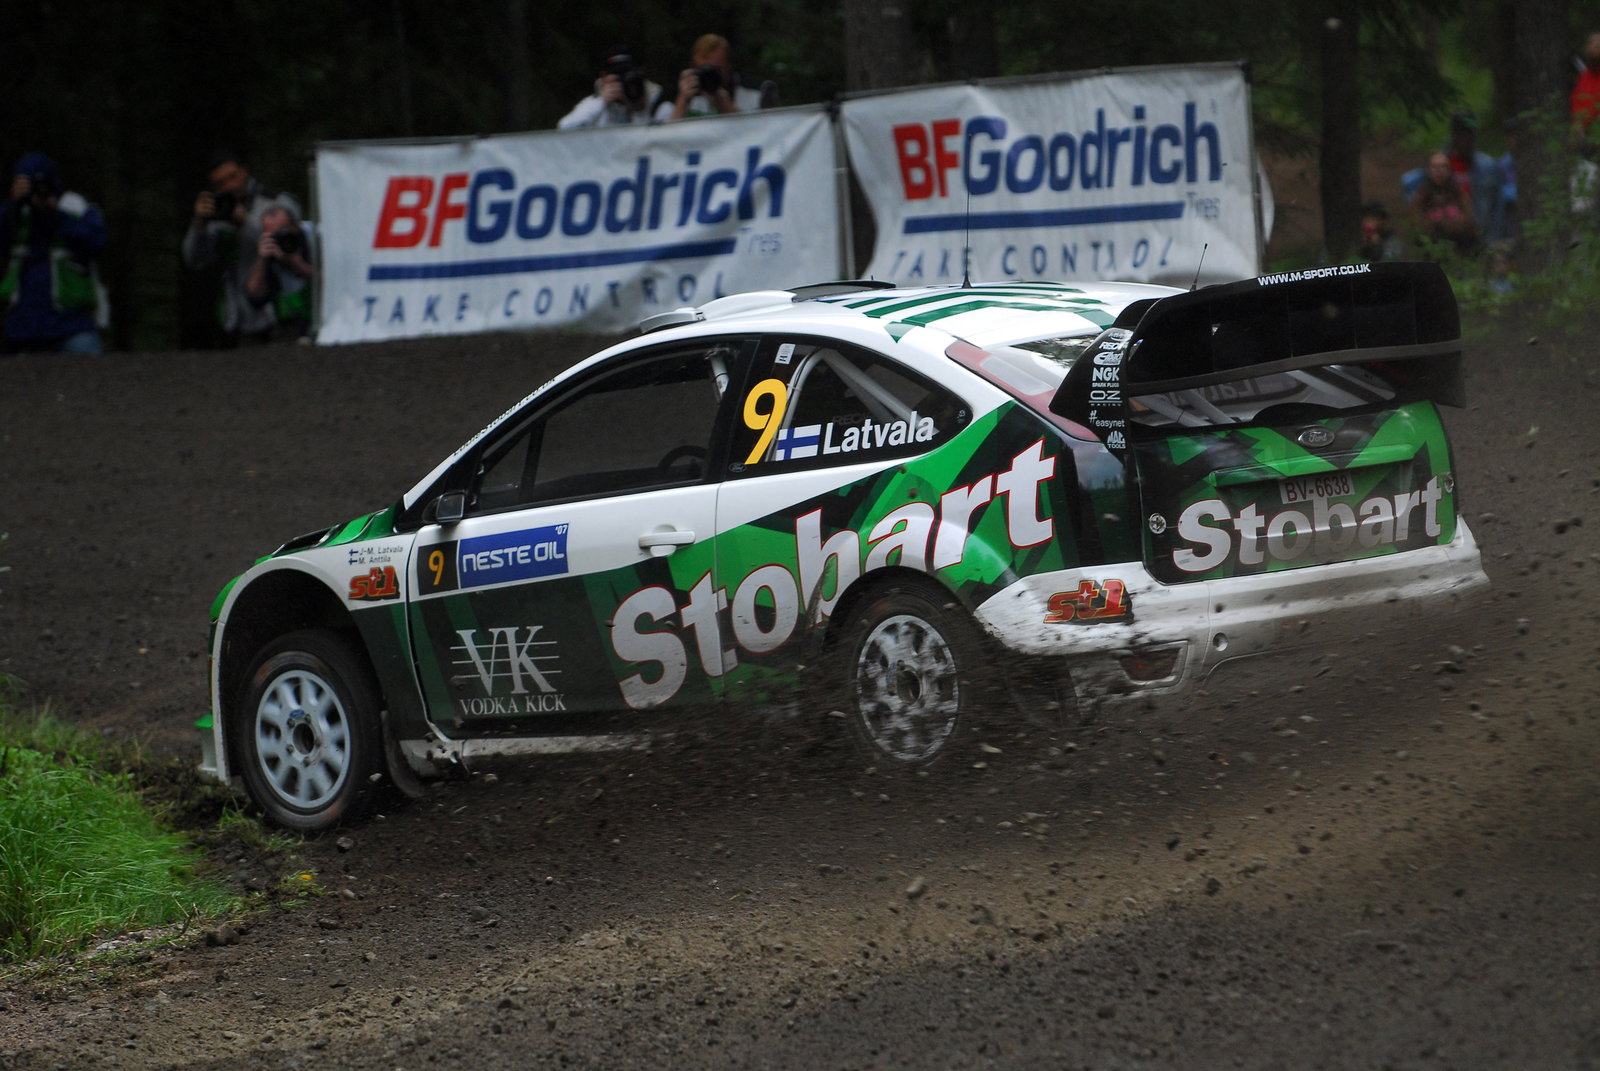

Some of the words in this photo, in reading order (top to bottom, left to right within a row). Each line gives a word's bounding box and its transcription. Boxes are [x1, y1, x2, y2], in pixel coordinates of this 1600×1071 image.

[892, 101, 1222, 201] BFGoodrich
[372, 145, 786, 250] BFGoodrich
[1001, 237, 1174, 277] CONTROL
[1257, 263, 1371, 286] WWW.M-SPORT.CO.UK
[363, 293, 469, 325] TAKE
[503, 271, 727, 318] CONTROL
[1092, 367, 1119, 381] NGK
[742, 378, 788, 465] 9
[823, 411, 935, 455] Latvala
[1107, 431, 1125, 443] MAC
[1285, 475, 1350, 502] BV-6638
[1173, 476, 1442, 573] Stobart
[428, 550, 445, 586] 9
[463, 545, 531, 573] NESTE
[535, 541, 565, 561] OIL
[612, 439, 1055, 710] Stobart
[348, 565, 398, 600] st1
[1043, 579, 1133, 624] st1
[456, 625, 557, 696] VK
[460, 696, 519, 715] VODKA
[525, 694, 567, 713] KICK
